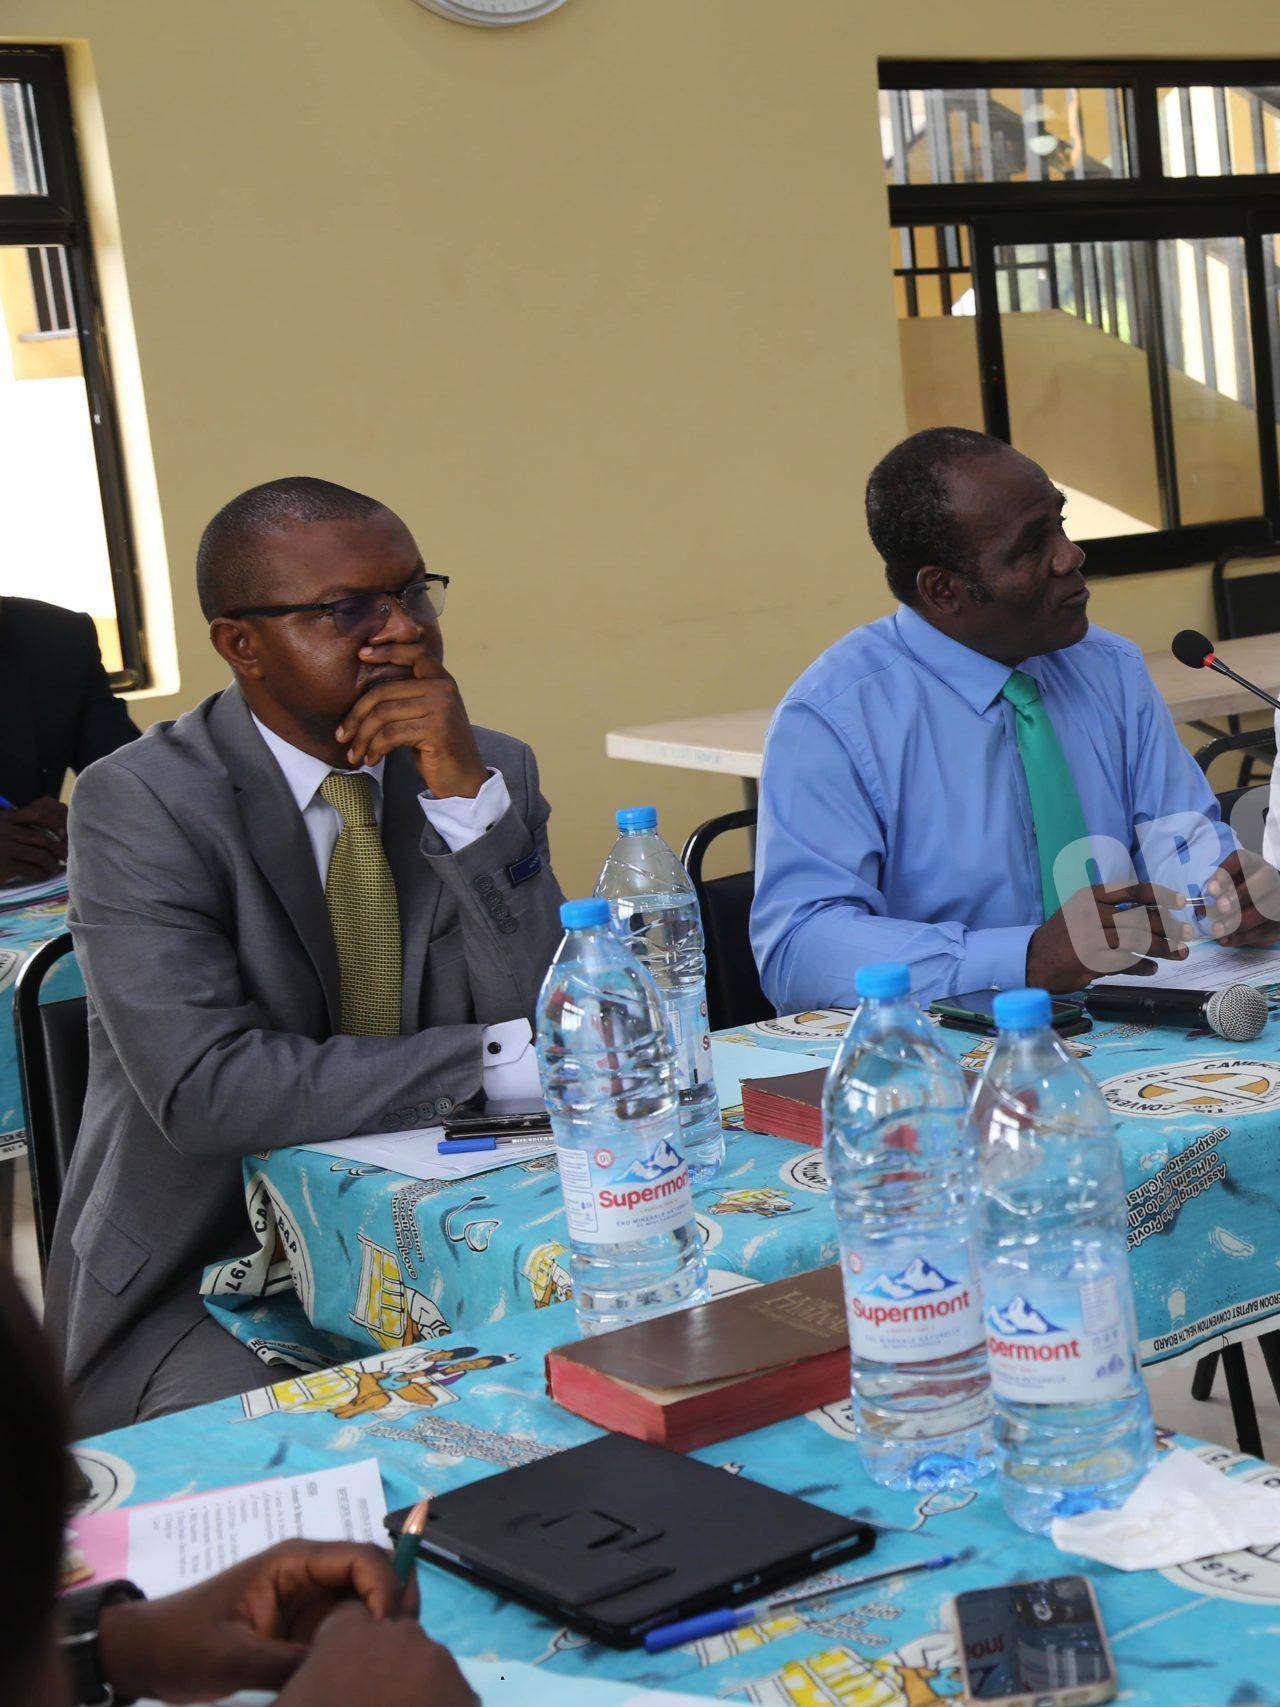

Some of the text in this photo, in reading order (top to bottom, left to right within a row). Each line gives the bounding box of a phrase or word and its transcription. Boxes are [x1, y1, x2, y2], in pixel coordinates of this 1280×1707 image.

[1216, 1128, 1229, 1139] an
[599, 1168, 690, 1211] Supermon
[1130, 1154, 1217, 1227] of Health to all
[1180, 1164, 1225, 1202] Assisting
[400, 1211, 411, 1230] all
[225, 1258, 254, 1296] 197
[400, 1247, 418, 1280] Love
[853, 1289, 969, 1327] Supermont
[1197, 1309, 1231, 1333] CONVENTION
[1232, 1300, 1258, 1318] BAPTIST
[1153, 1334, 1178, 1351] BOARD
[1179, 1325, 1196, 1342] HEALTH
